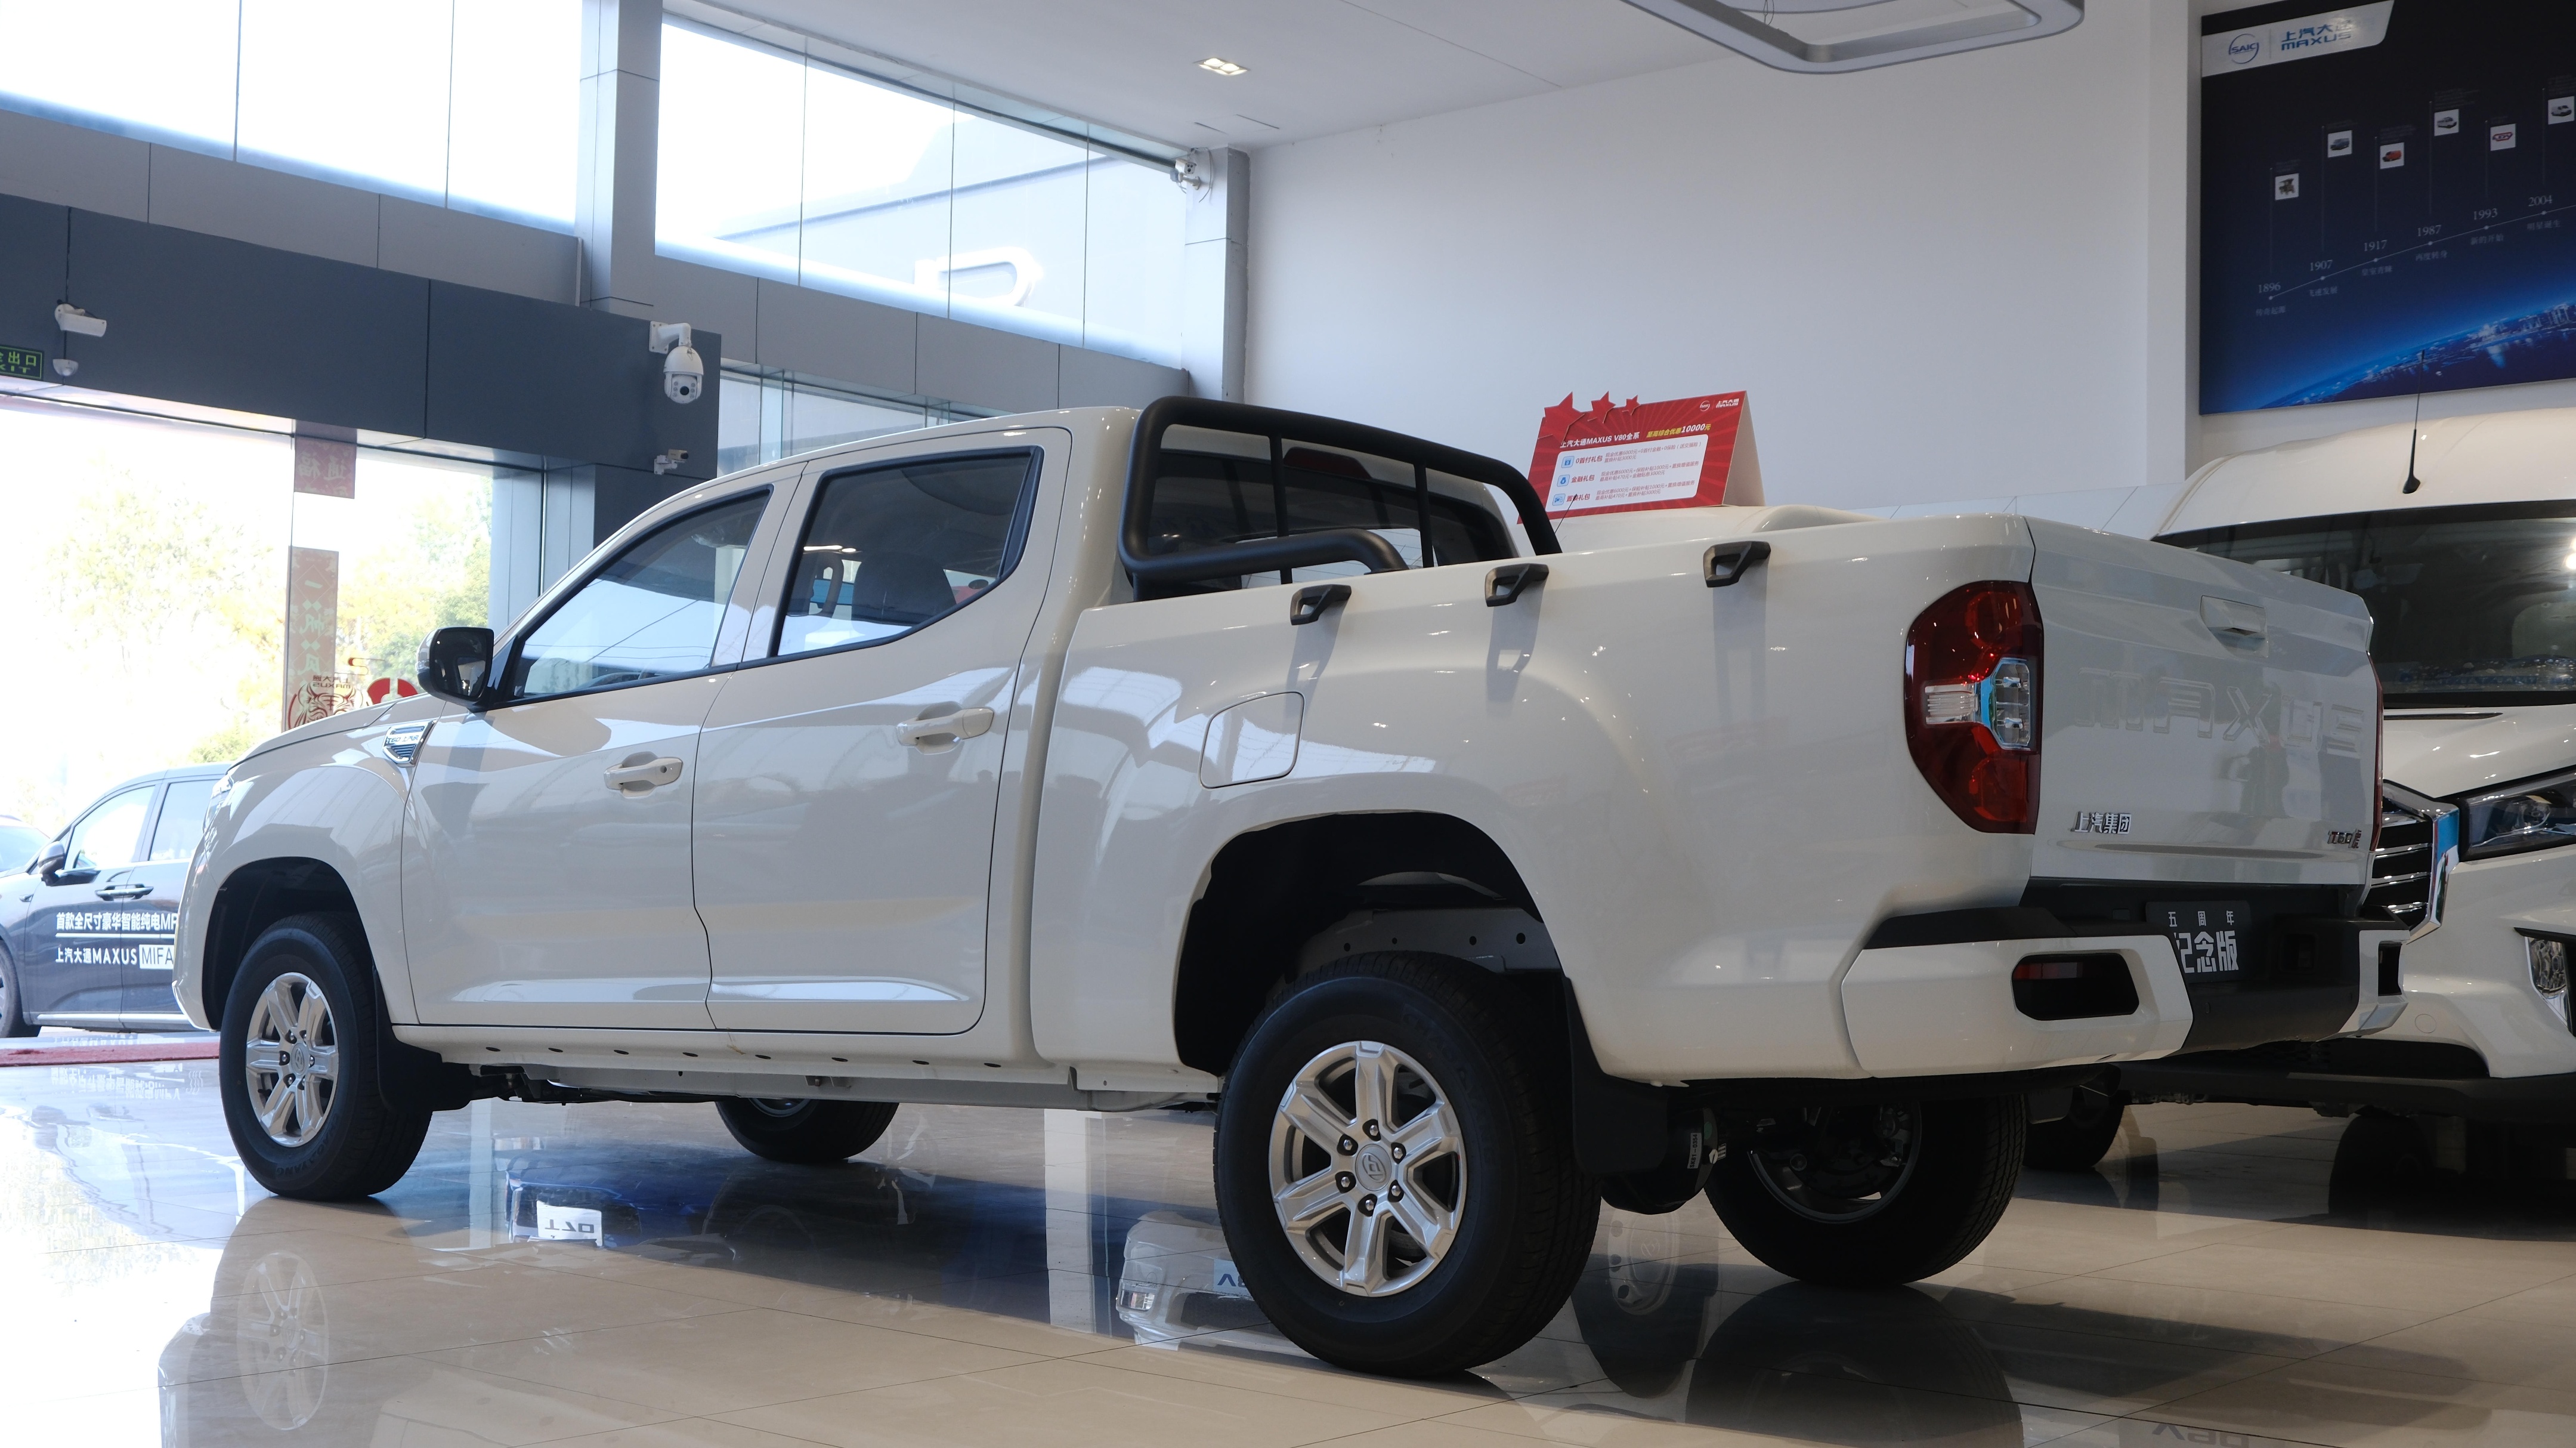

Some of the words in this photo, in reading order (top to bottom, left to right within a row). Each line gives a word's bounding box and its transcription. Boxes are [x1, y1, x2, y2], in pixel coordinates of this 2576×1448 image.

[2281, 31, 2352, 50] MAXUS
[2528, 194, 2553, 206] 2004
[2473, 208, 2498, 220] 1993
[2417, 224, 2442, 237] 1987
[2363, 239, 2387, 252] 1917
[2309, 260, 2333, 271] 1907
[2258, 282, 2281, 294] 1896
[1576, 455, 1603, 464] 0首付礼包
[1571, 474, 1595, 483] 金融礼包
[2074, 667, 2364, 759] MAXUS
[2073, 811, 2132, 834] 上汽集团
[2168, 910, 2235, 927] 五周年
[55, 947, 138, 965] 上汽大通MAXUS
